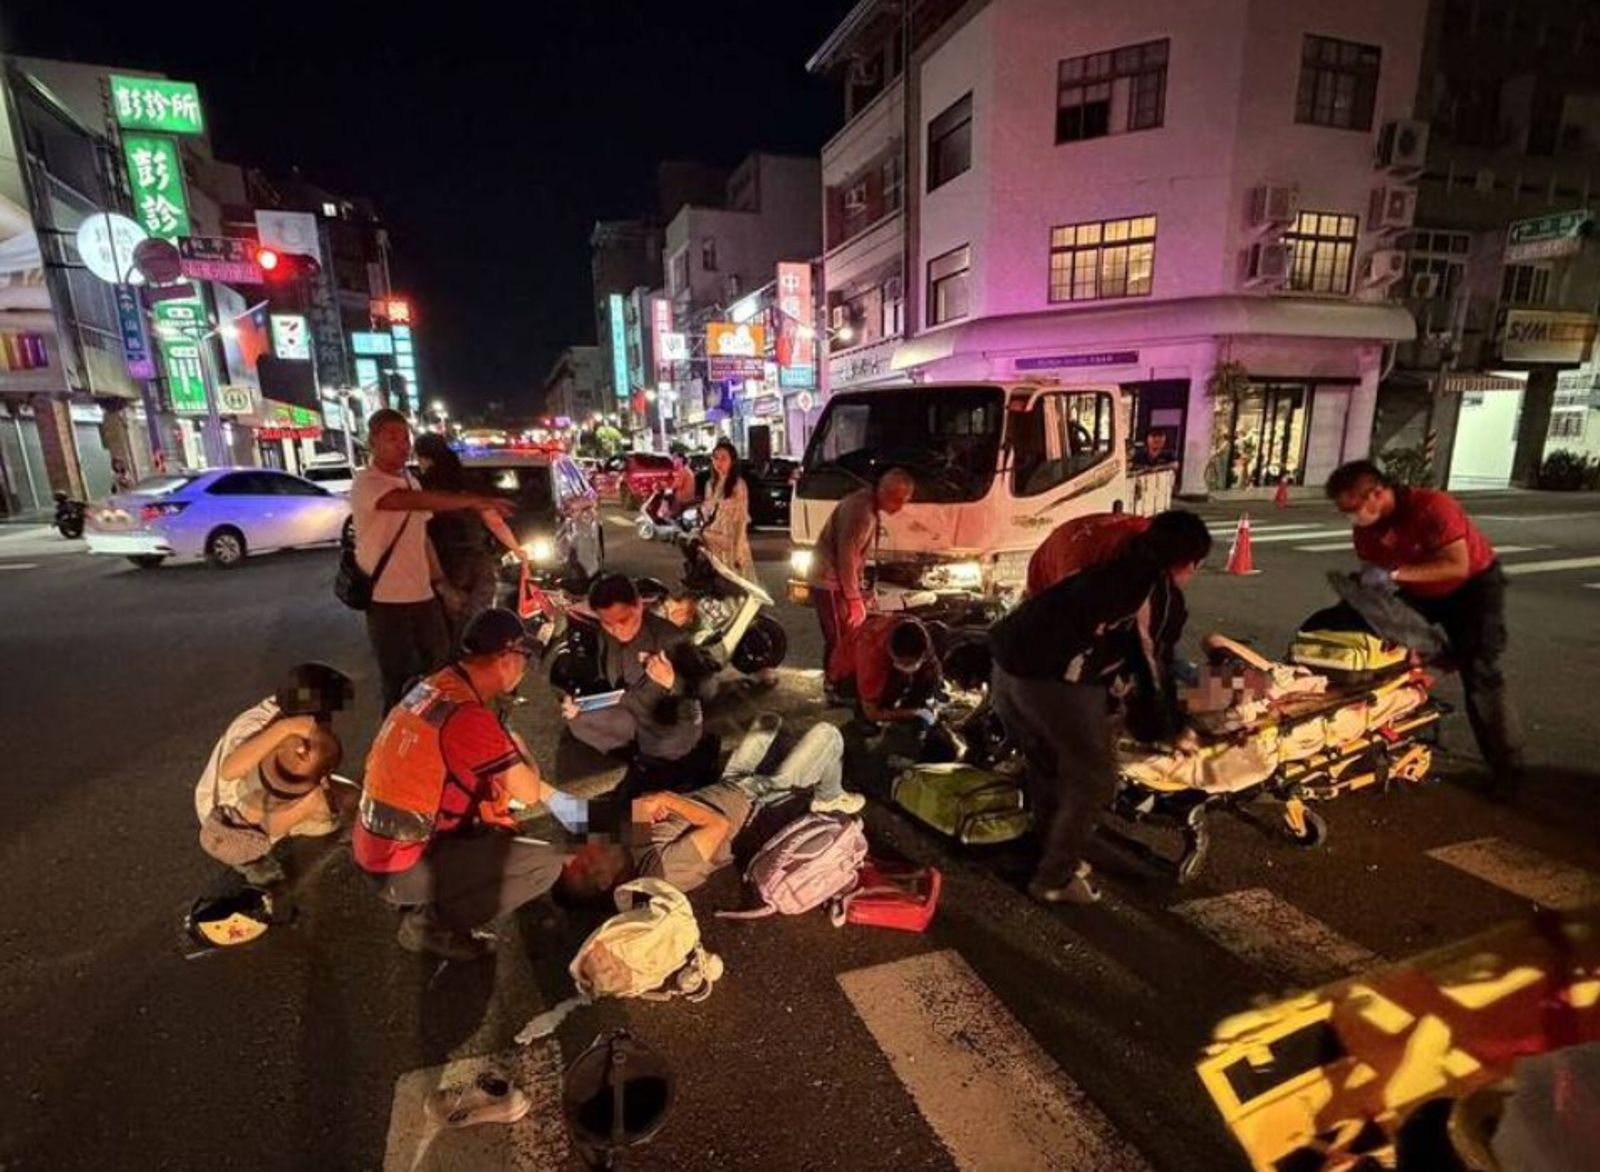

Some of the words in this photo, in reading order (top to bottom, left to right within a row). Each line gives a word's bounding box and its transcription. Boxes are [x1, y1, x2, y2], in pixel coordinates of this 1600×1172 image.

[115, 86, 198, 126] 彭診所
[131, 147, 182, 248] 彭診
